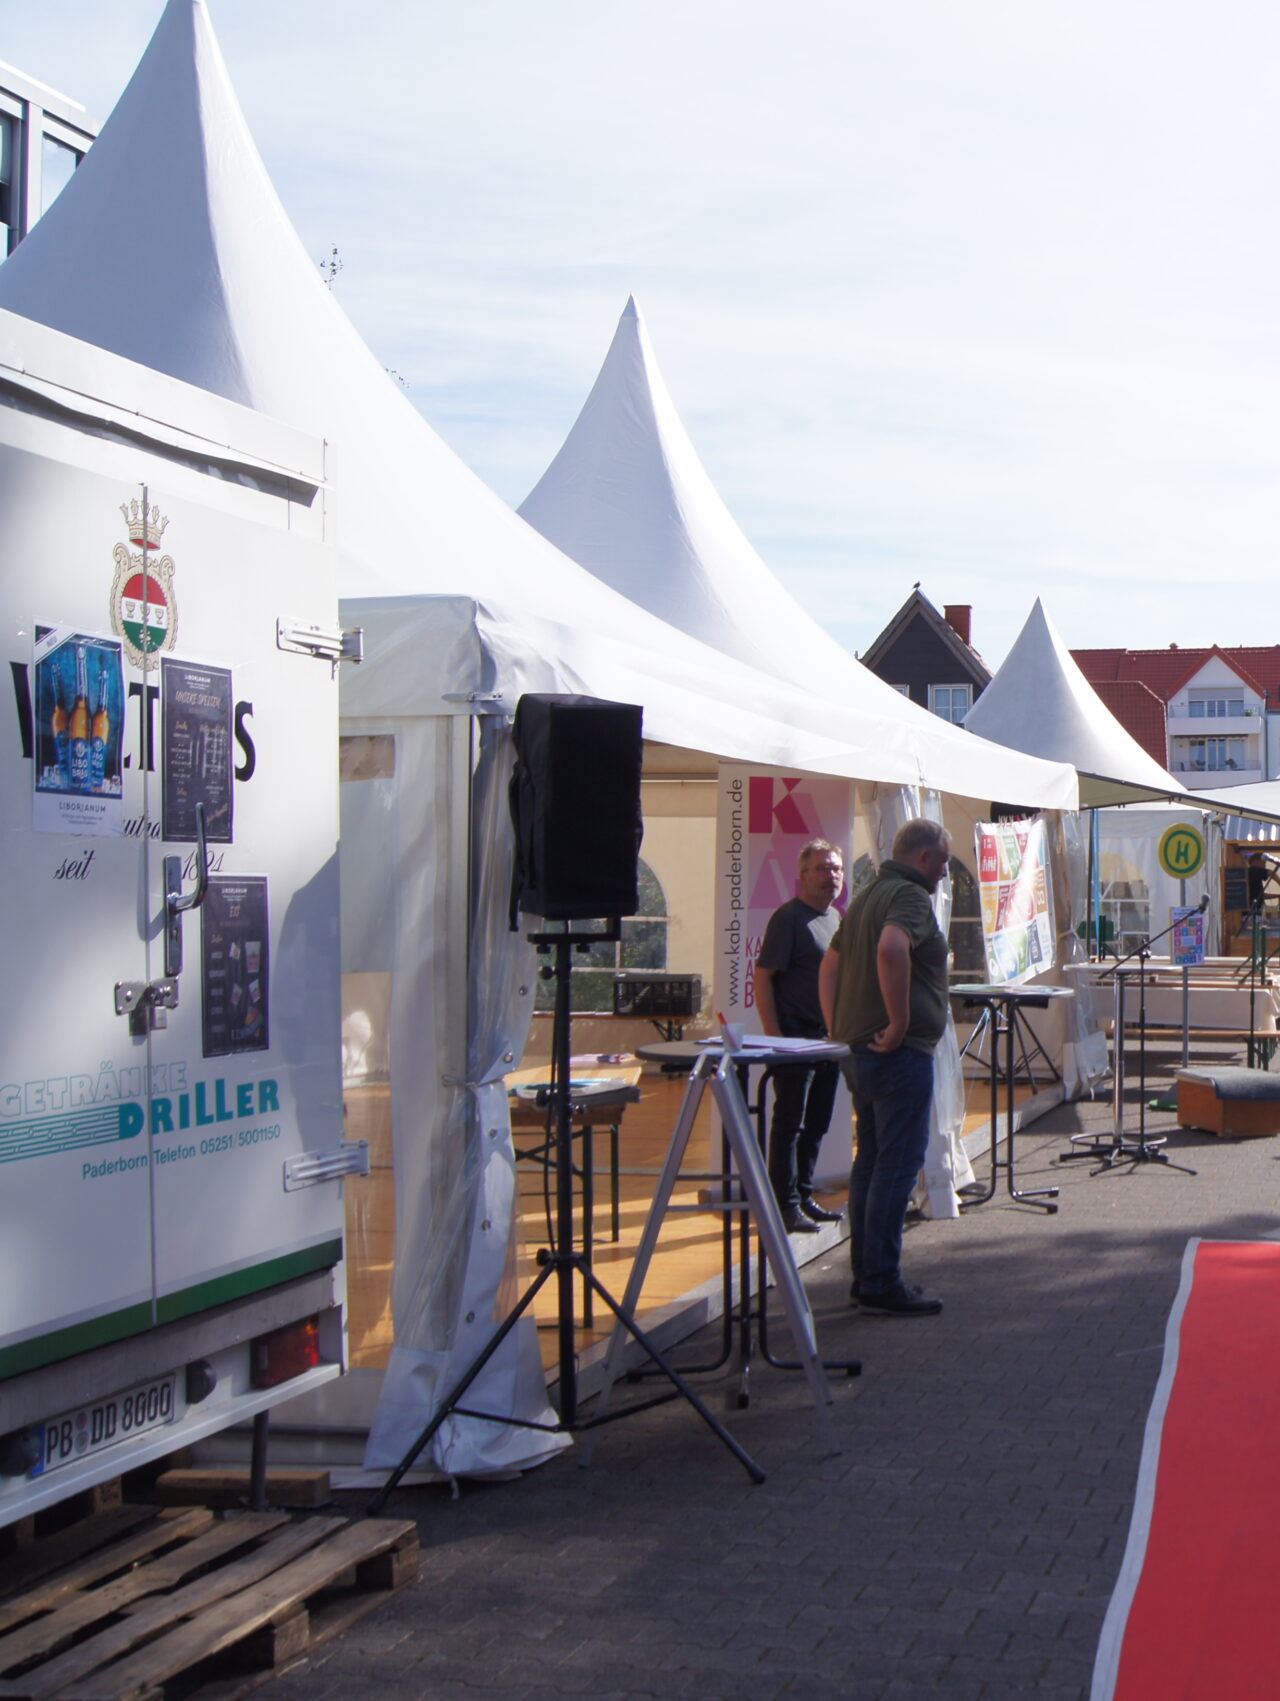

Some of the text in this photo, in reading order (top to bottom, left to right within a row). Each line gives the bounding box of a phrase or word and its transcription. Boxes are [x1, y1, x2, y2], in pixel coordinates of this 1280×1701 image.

[53, 849, 96, 880] seit
[1174, 840, 1190, 865] H
[724, 778, 745, 1007] www.kab-paderborn.de
[0, 1060, 188, 1118] GETRÄNKE
[118, 1078, 281, 1140] DRILLER
[82, 1154, 149, 1180] Paderborn
[154, 1144, 196, 1165] Telefon
[46, 1420, 73, 1464] PB
[90, 1402, 117, 1445] DD
